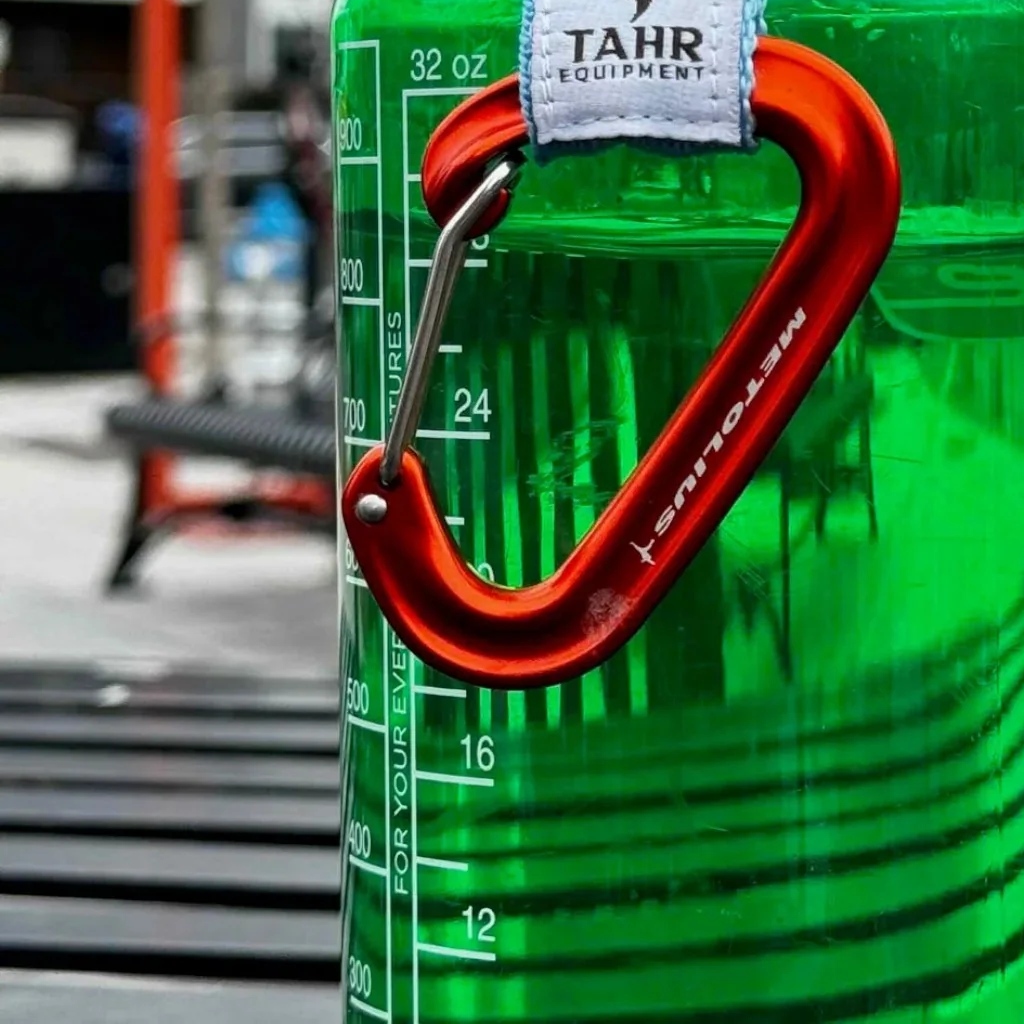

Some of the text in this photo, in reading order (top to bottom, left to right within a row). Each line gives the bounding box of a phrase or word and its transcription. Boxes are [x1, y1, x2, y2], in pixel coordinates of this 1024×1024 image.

[563, 25, 703, 63] TAHR
[410, 48, 442, 81] 32
[558, 63, 705, 83] EQUIPMENT
[339, 117, 362, 151] 900
[340, 258, 363, 292] 800
[343, 396, 366, 432] 700
[454, 388, 492, 422] 24
[654, 306, 807, 537] METOLIUS
[347, 677, 370, 715] 500
[393, 725, 408, 817] YOUR
[460, 734, 495, 771] 16
[393, 827, 409, 895] FOR
[462, 905, 496, 942] 12
[349, 955, 372, 999] 300
